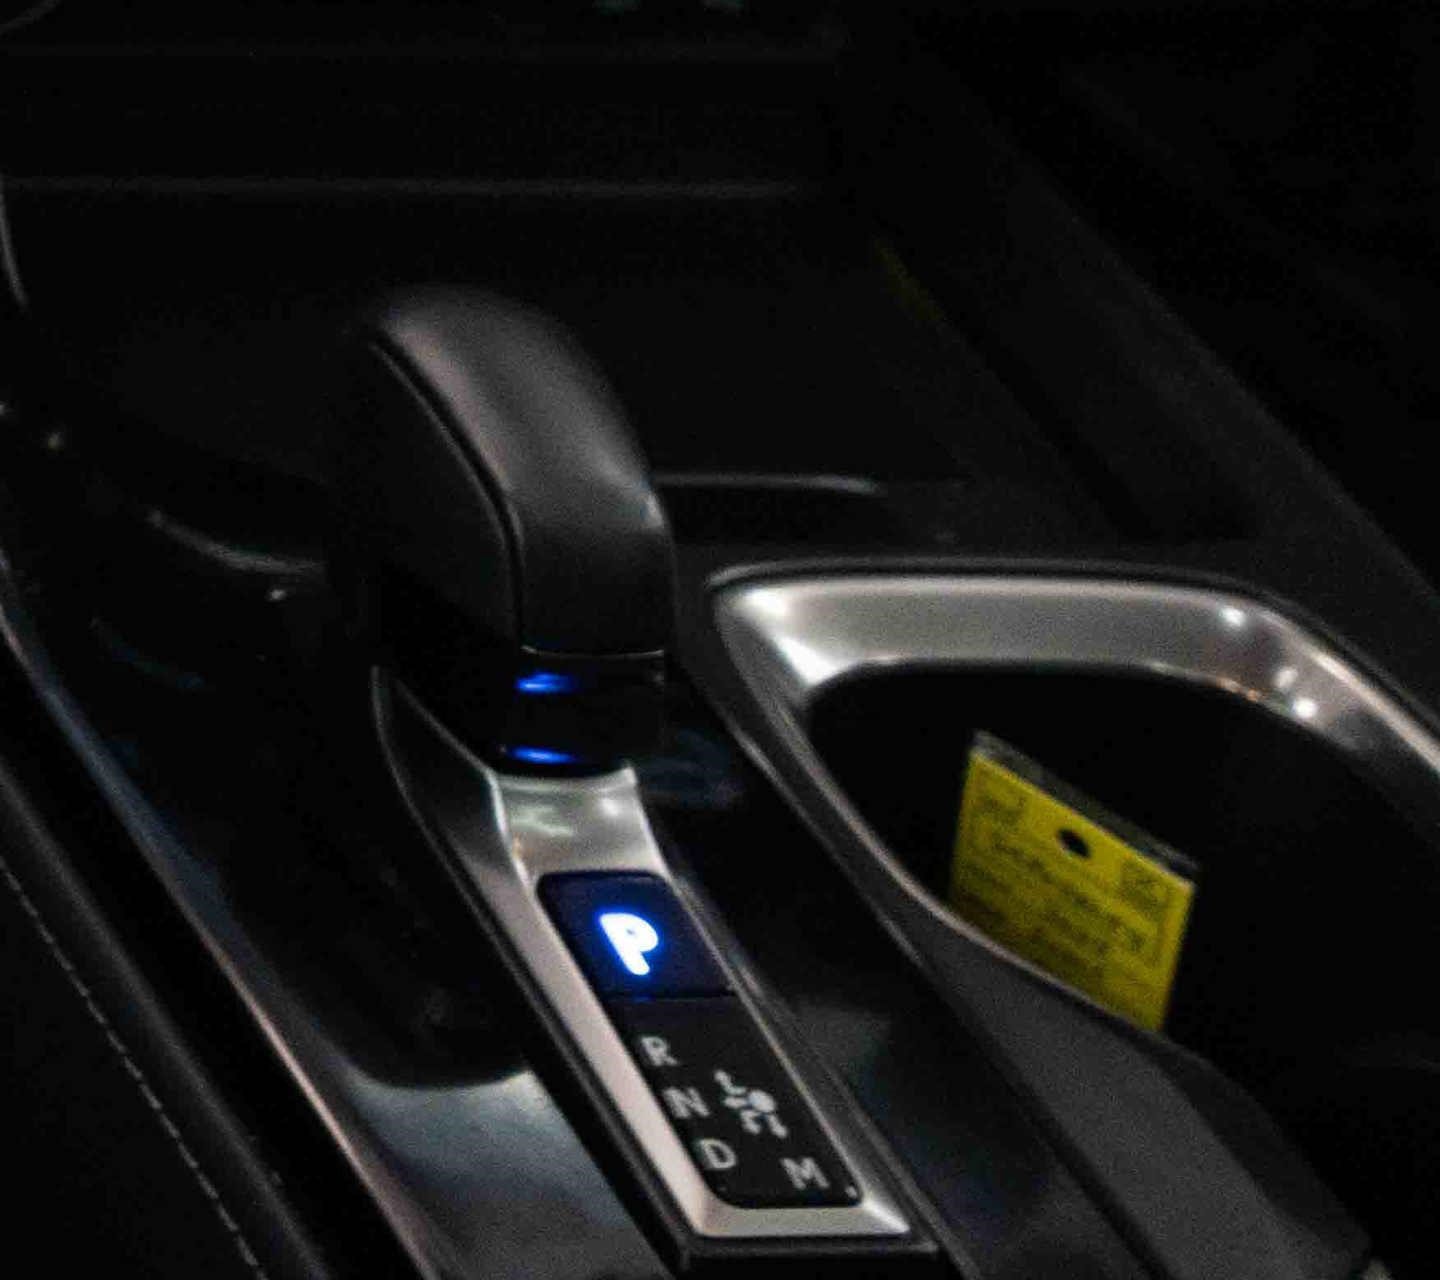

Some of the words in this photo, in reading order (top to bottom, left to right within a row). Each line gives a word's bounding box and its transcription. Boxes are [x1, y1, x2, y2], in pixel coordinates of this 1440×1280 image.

[598, 912, 660, 976] P
[640, 1035, 678, 1067] R
[663, 1086, 710, 1120] N
[698, 1138, 737, 1170] D
[782, 1156, 831, 1191] M
